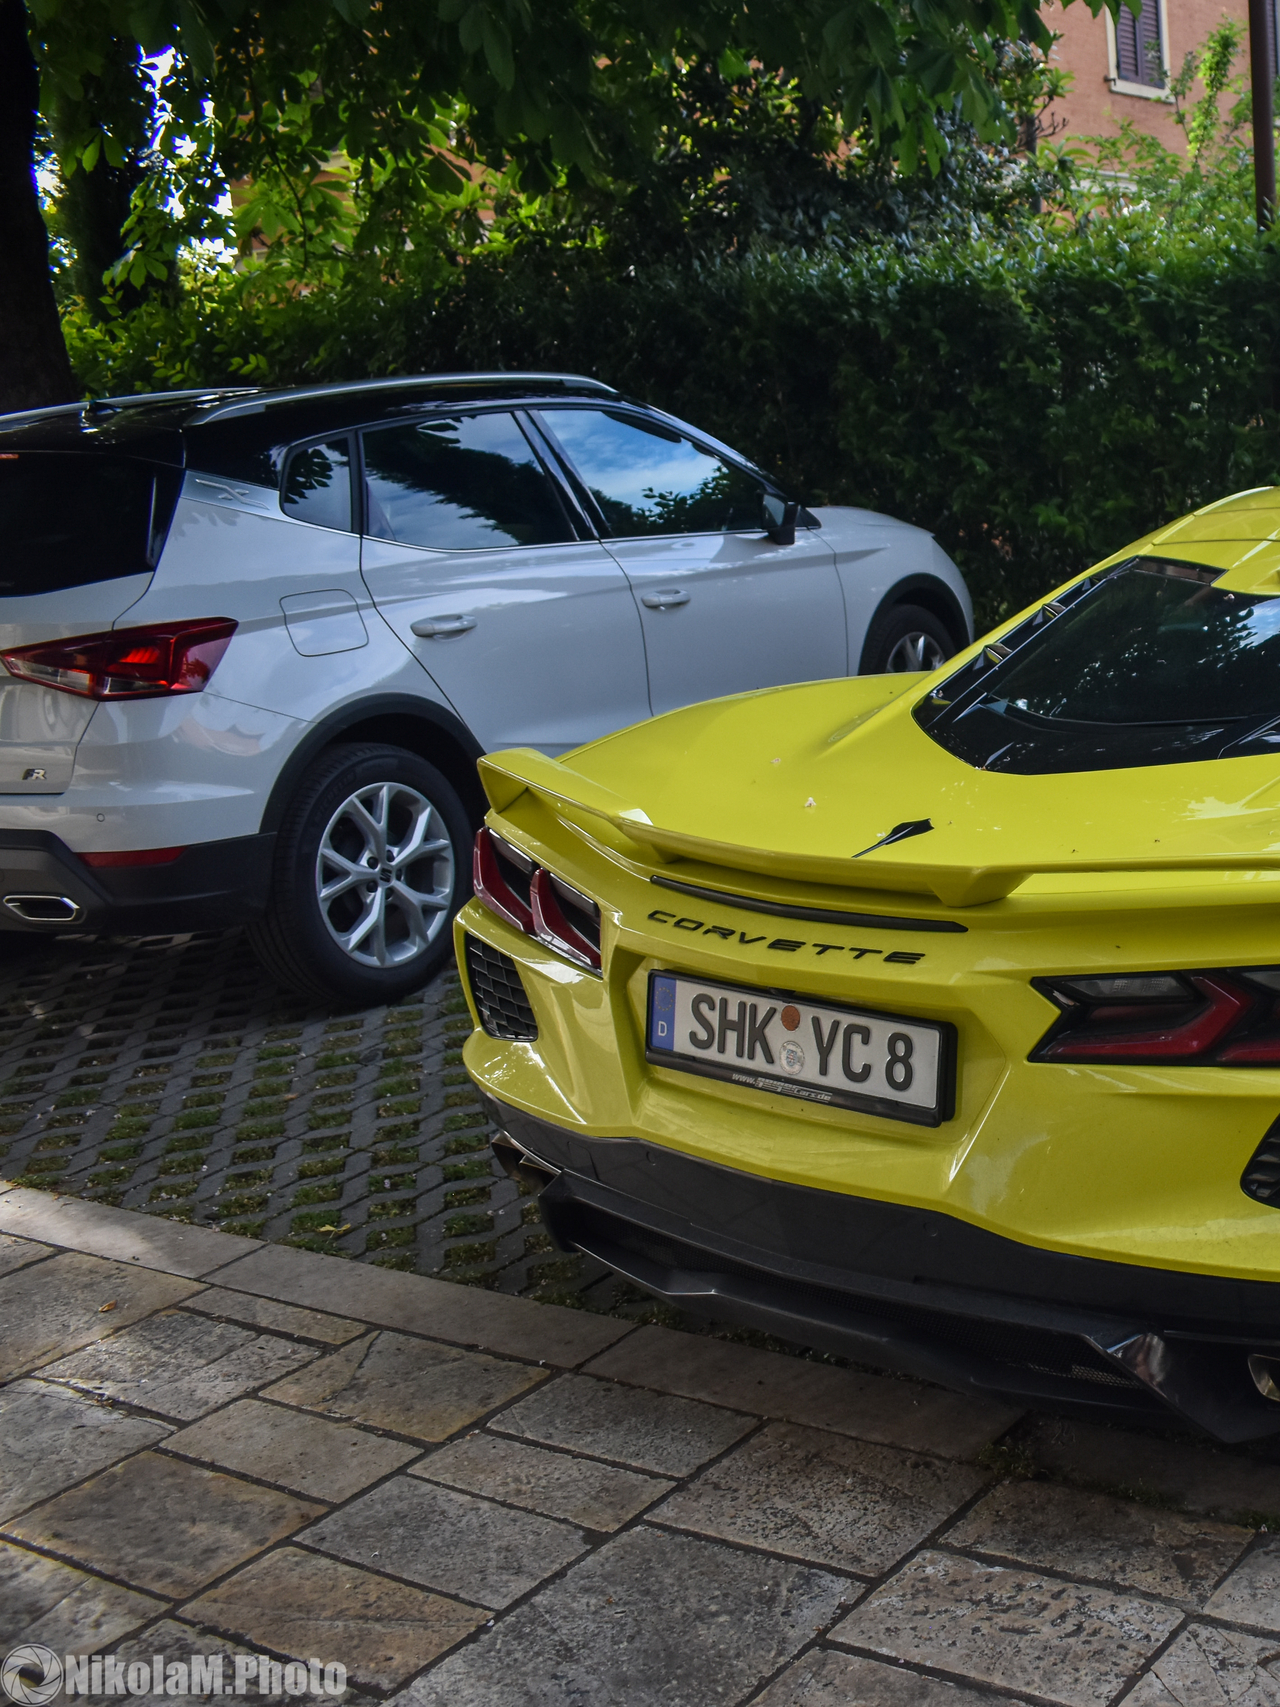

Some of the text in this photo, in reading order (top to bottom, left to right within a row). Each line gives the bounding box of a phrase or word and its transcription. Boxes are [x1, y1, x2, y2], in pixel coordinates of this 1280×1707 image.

[647, 909, 926, 964] CORVETTE
[657, 1021, 667, 1036] D
[689, 993, 913, 1091] SHK YC 8
